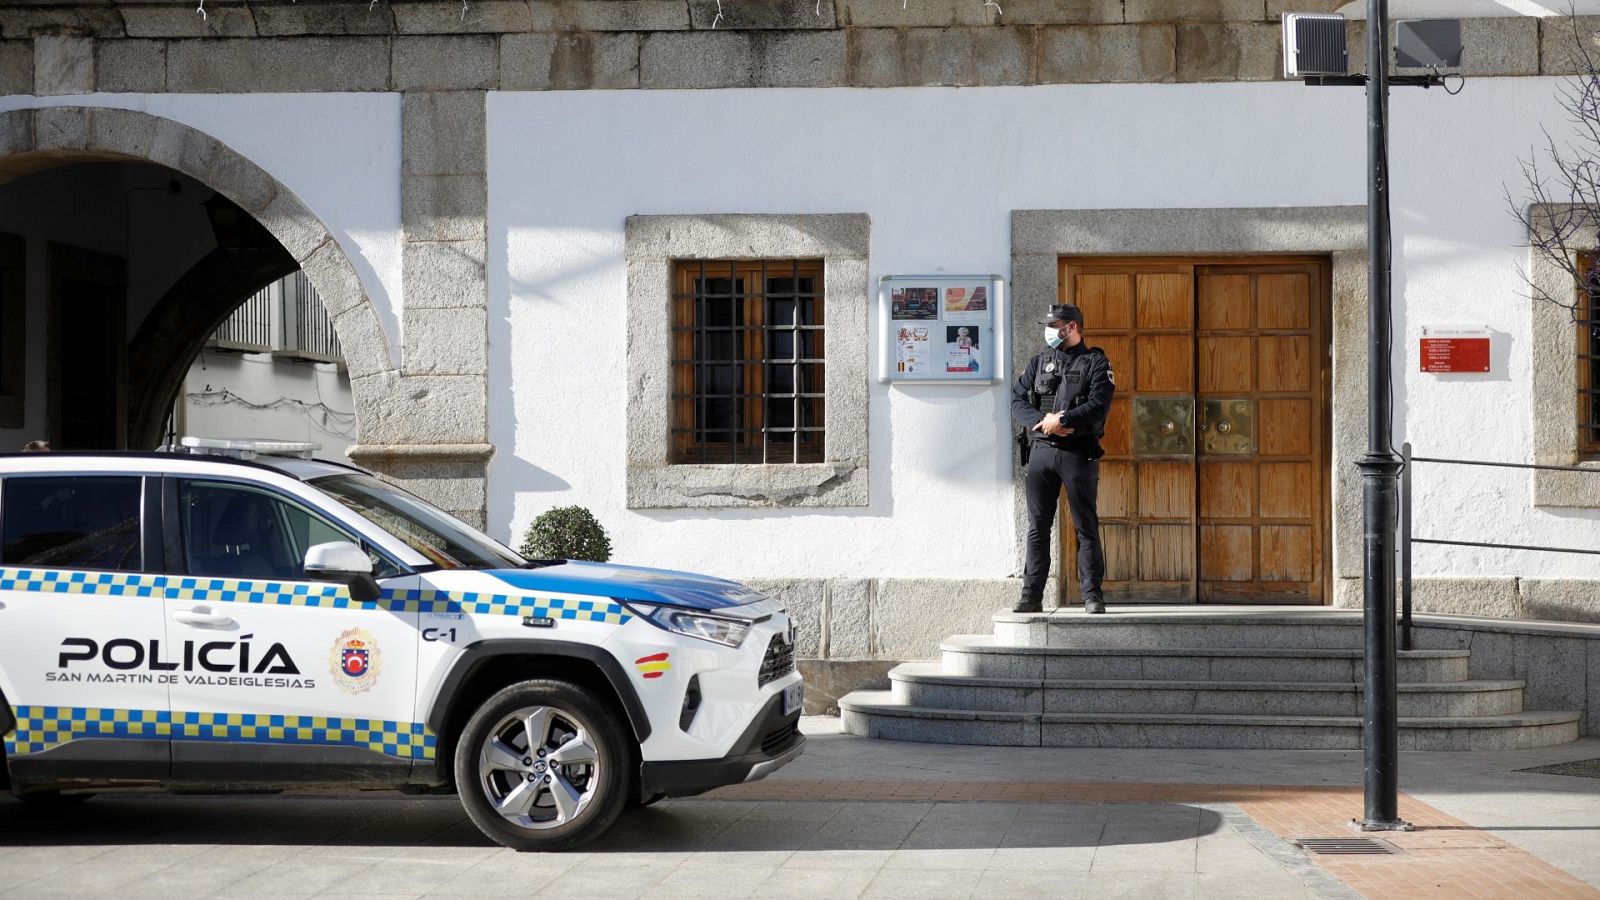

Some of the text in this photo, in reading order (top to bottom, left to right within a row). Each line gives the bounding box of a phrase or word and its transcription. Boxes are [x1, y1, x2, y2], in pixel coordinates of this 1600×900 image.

[422, 628, 456, 642] C-1
[59, 633, 301, 675] POLICÍA
[45, 672, 316, 689] SAN MARTIN DE VALDEIGLESIAS
